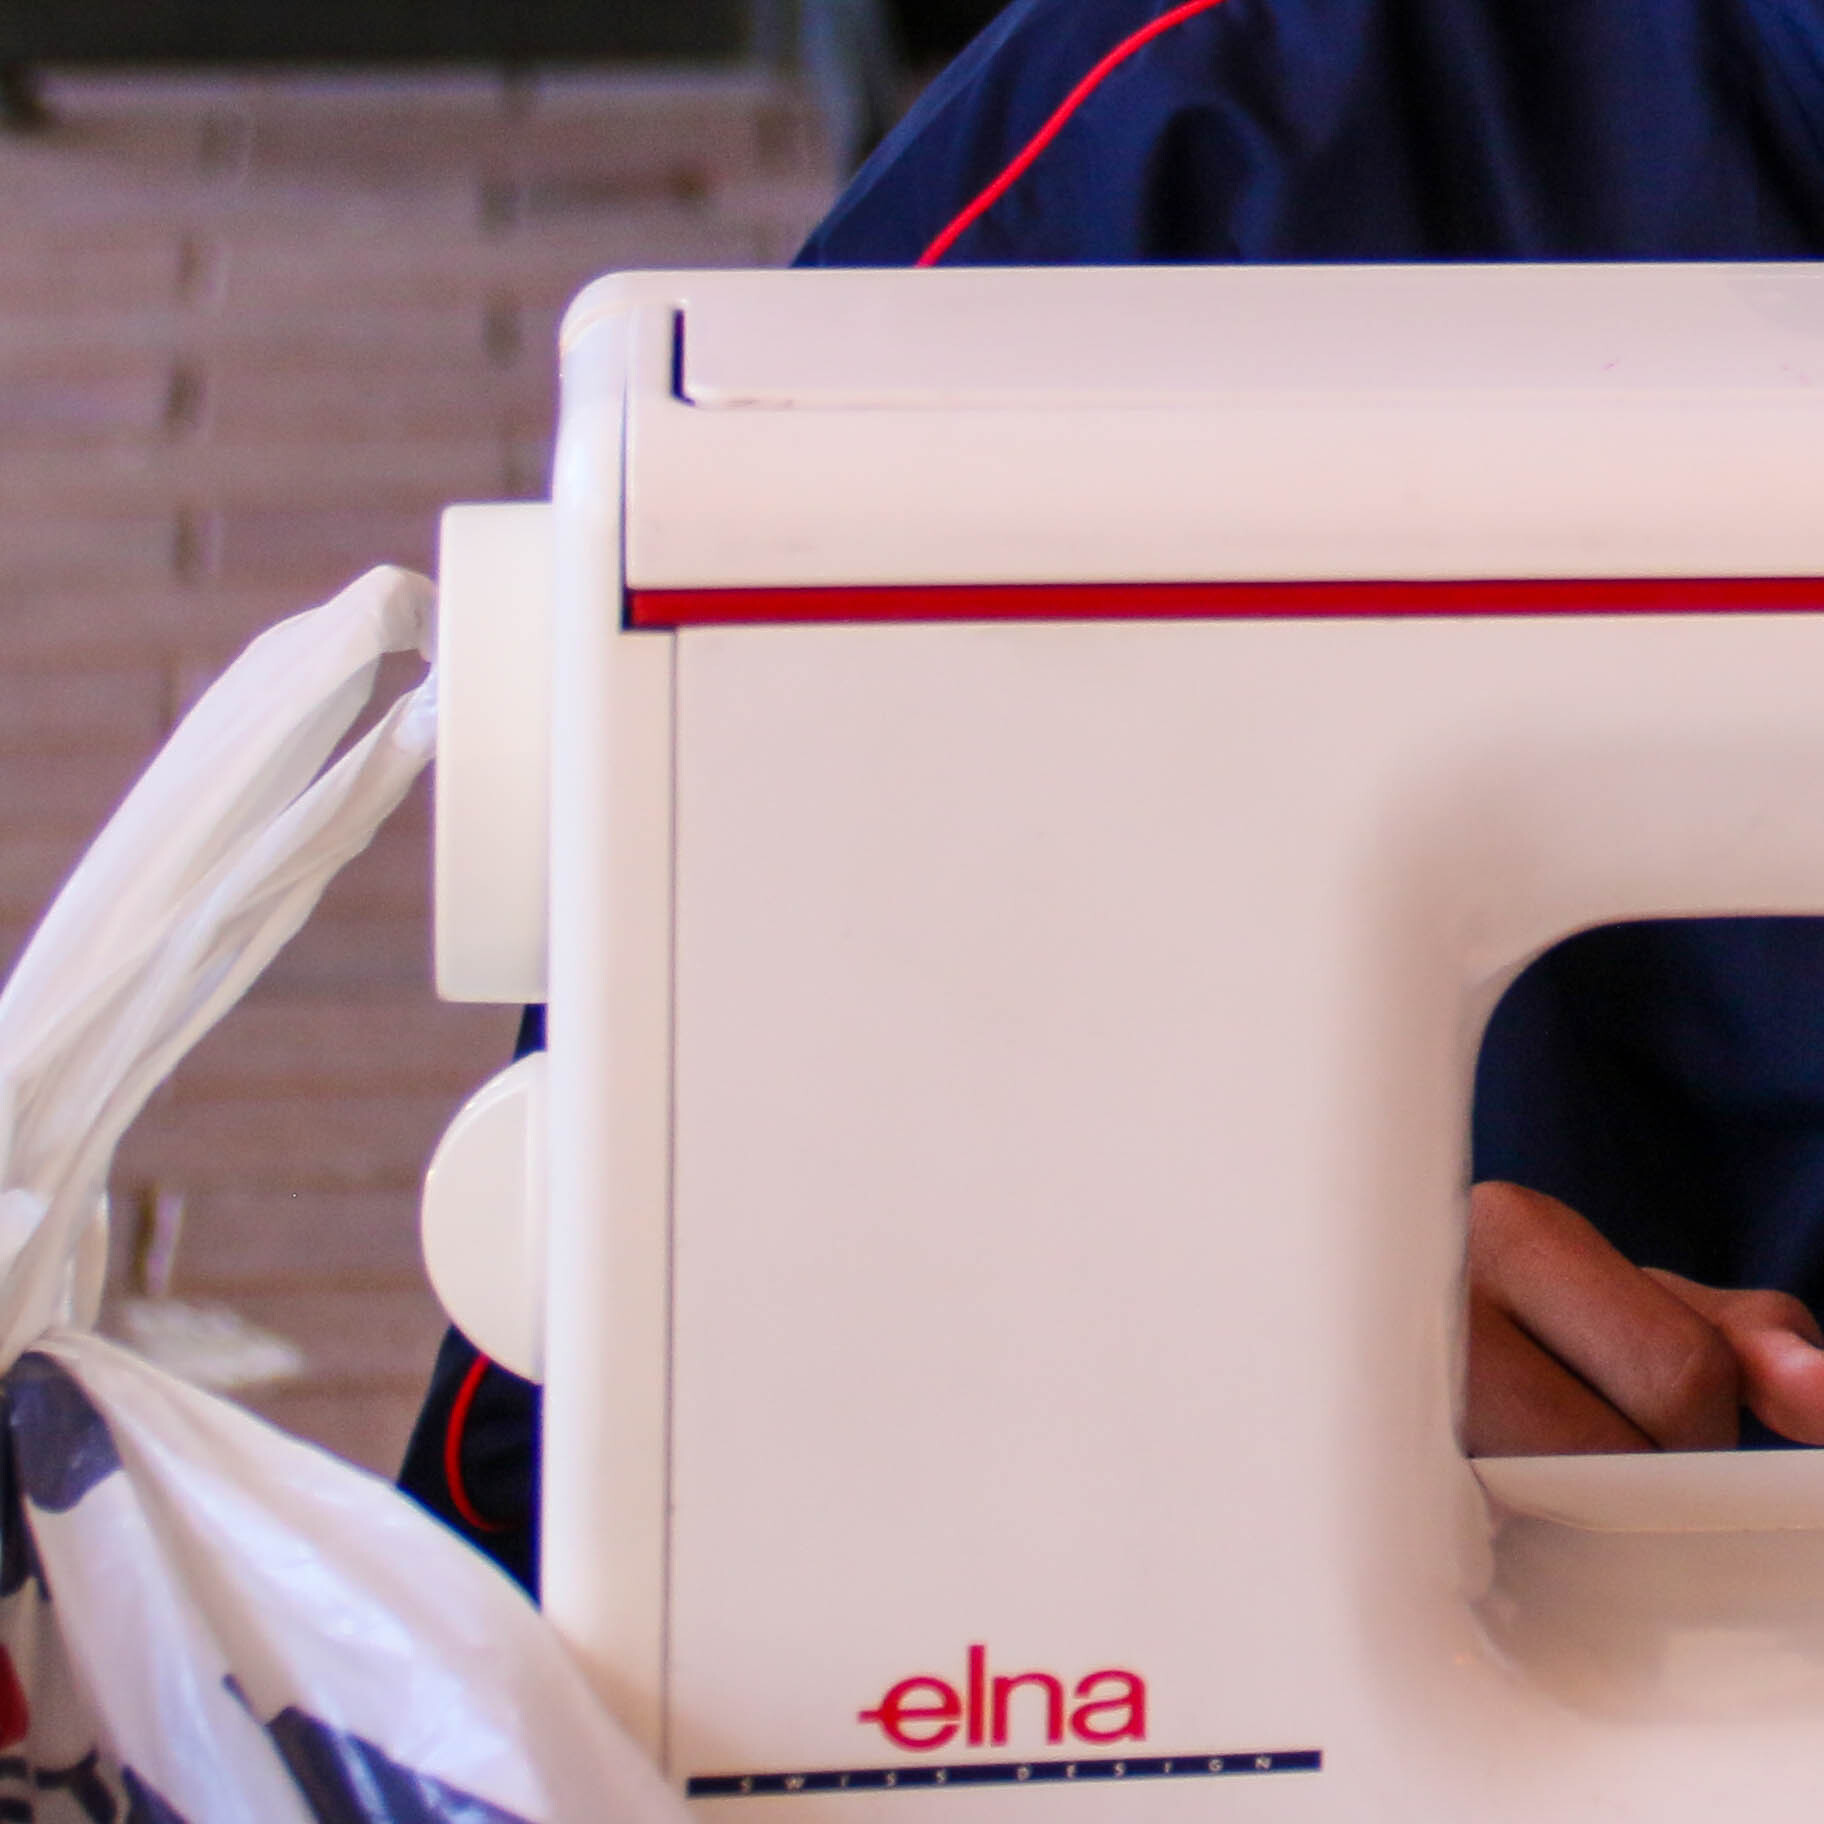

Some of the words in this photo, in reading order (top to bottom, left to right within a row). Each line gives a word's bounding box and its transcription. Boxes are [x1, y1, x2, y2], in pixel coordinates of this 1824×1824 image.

[858, 1643, 1147, 1751] elna
[740, 1769, 947, 1792] SWISS
[1018, 1756, 1271, 1780] DESIGN
